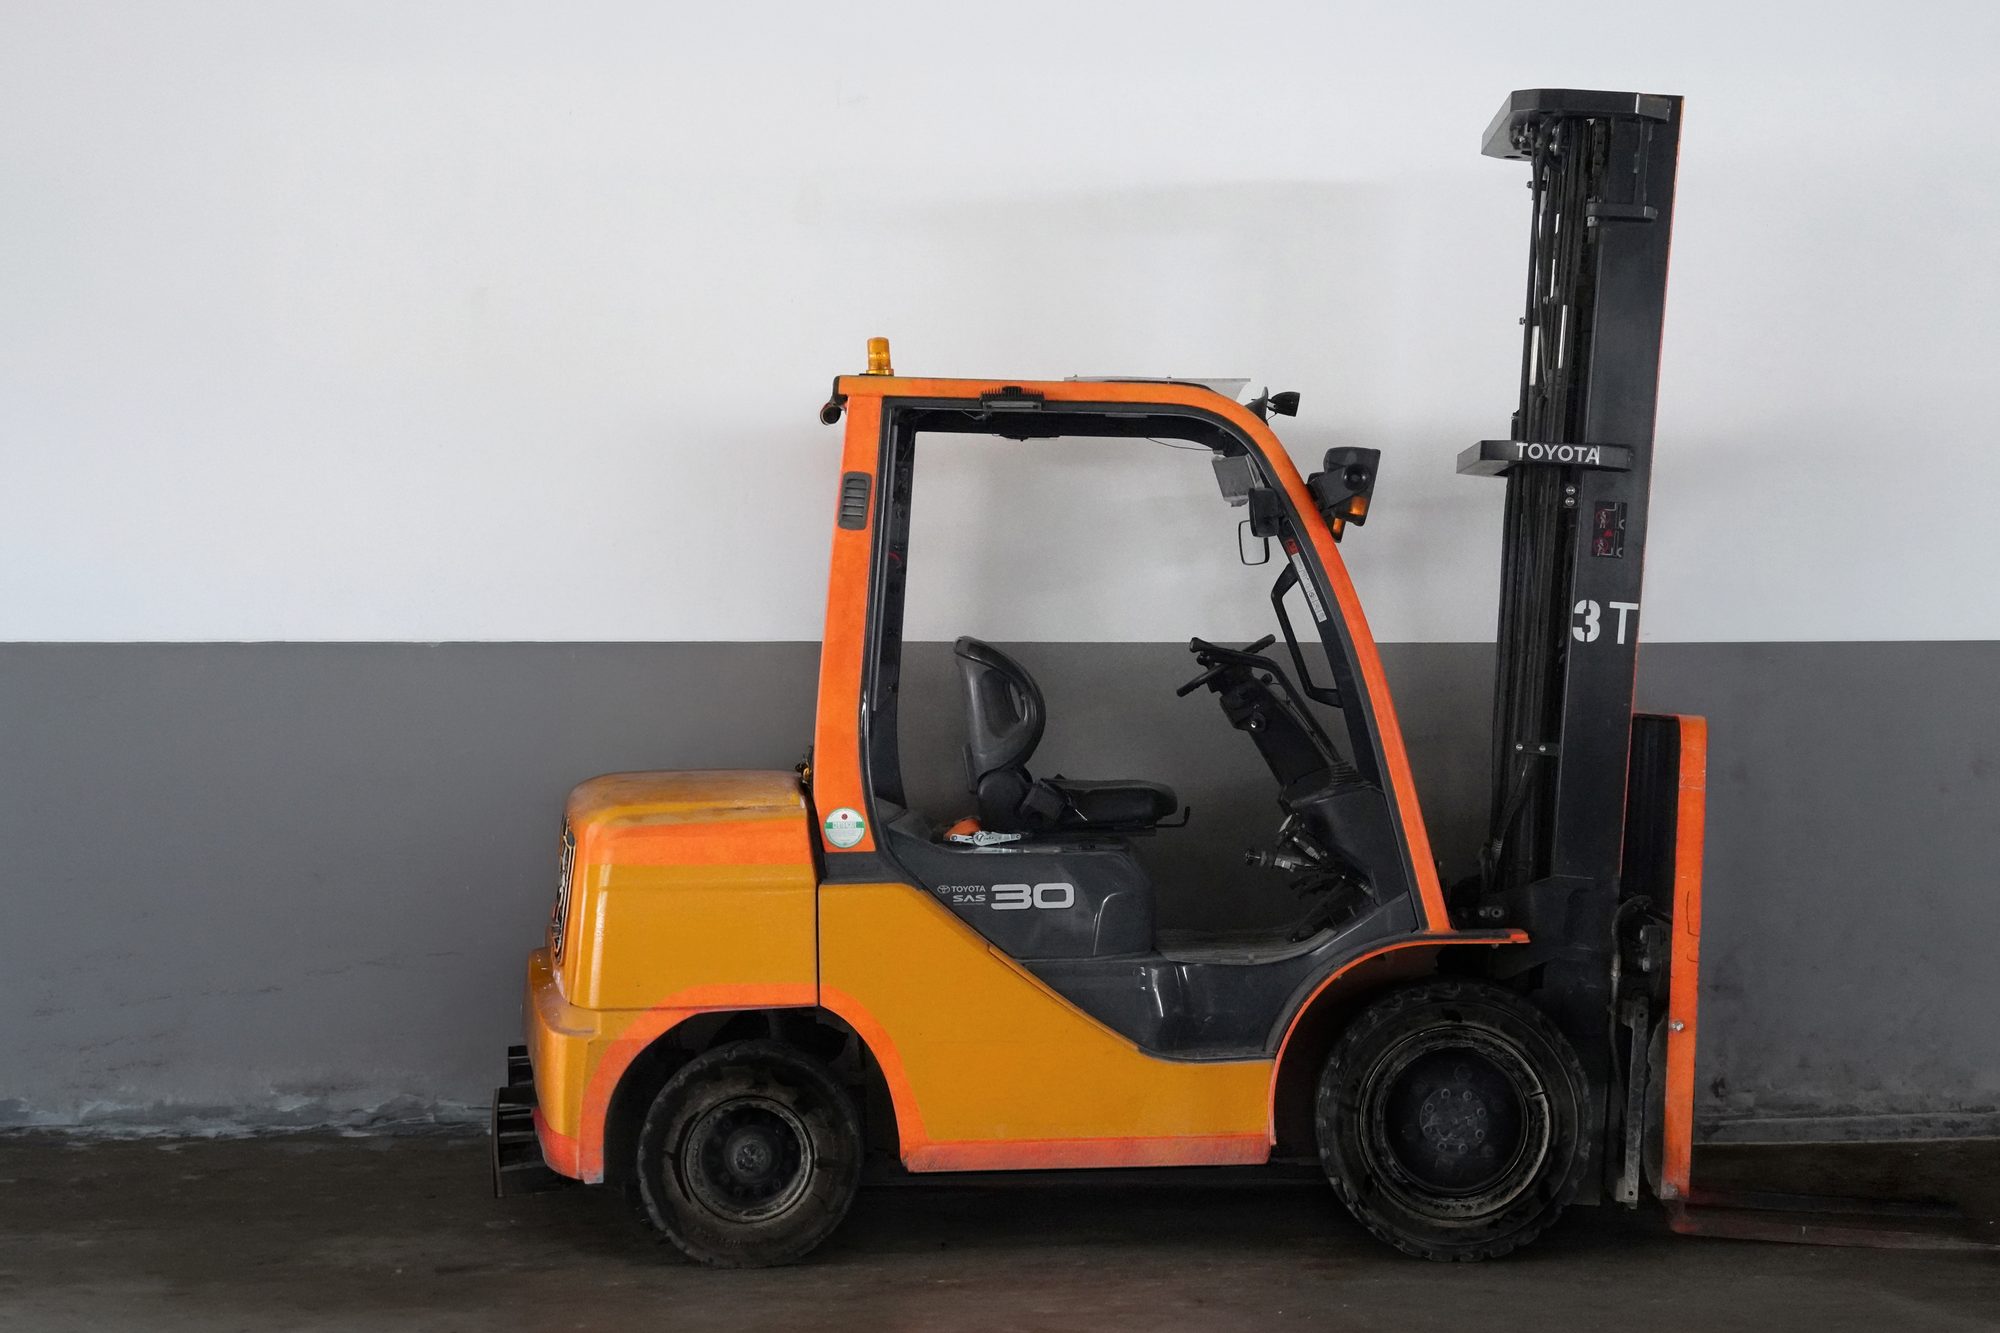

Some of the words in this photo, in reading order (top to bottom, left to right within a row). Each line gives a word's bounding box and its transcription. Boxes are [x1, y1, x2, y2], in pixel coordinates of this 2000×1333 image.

[1516, 442, 1601, 465] TOYOTA
[951, 885, 986, 893] TOYOTA
[990, 882, 1075, 910] 30
[953, 894, 986, 903] SAS
